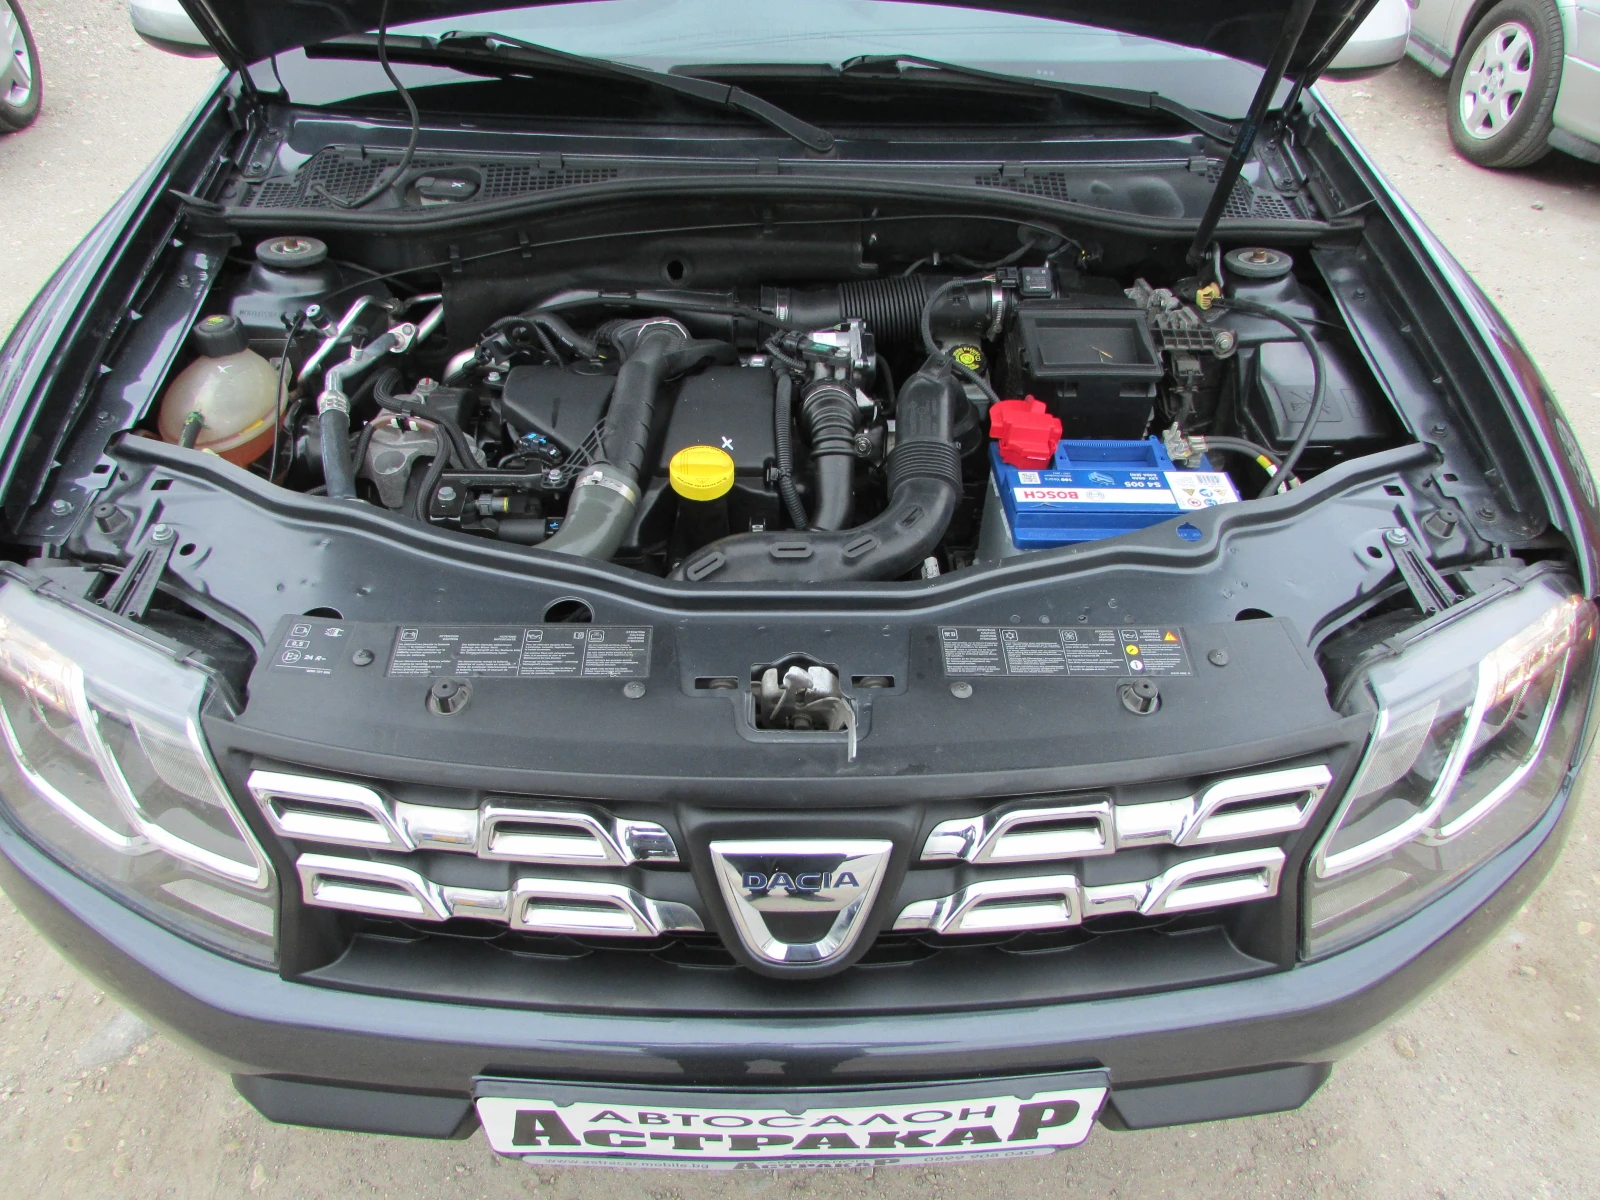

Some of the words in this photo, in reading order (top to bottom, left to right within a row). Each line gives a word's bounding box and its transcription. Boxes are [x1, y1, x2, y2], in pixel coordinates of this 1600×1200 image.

[1023, 491, 1079, 499] BOSCH
[742, 872, 859, 892] DACIA
[588, 1105, 997, 1128] АВТОСАЛОН
